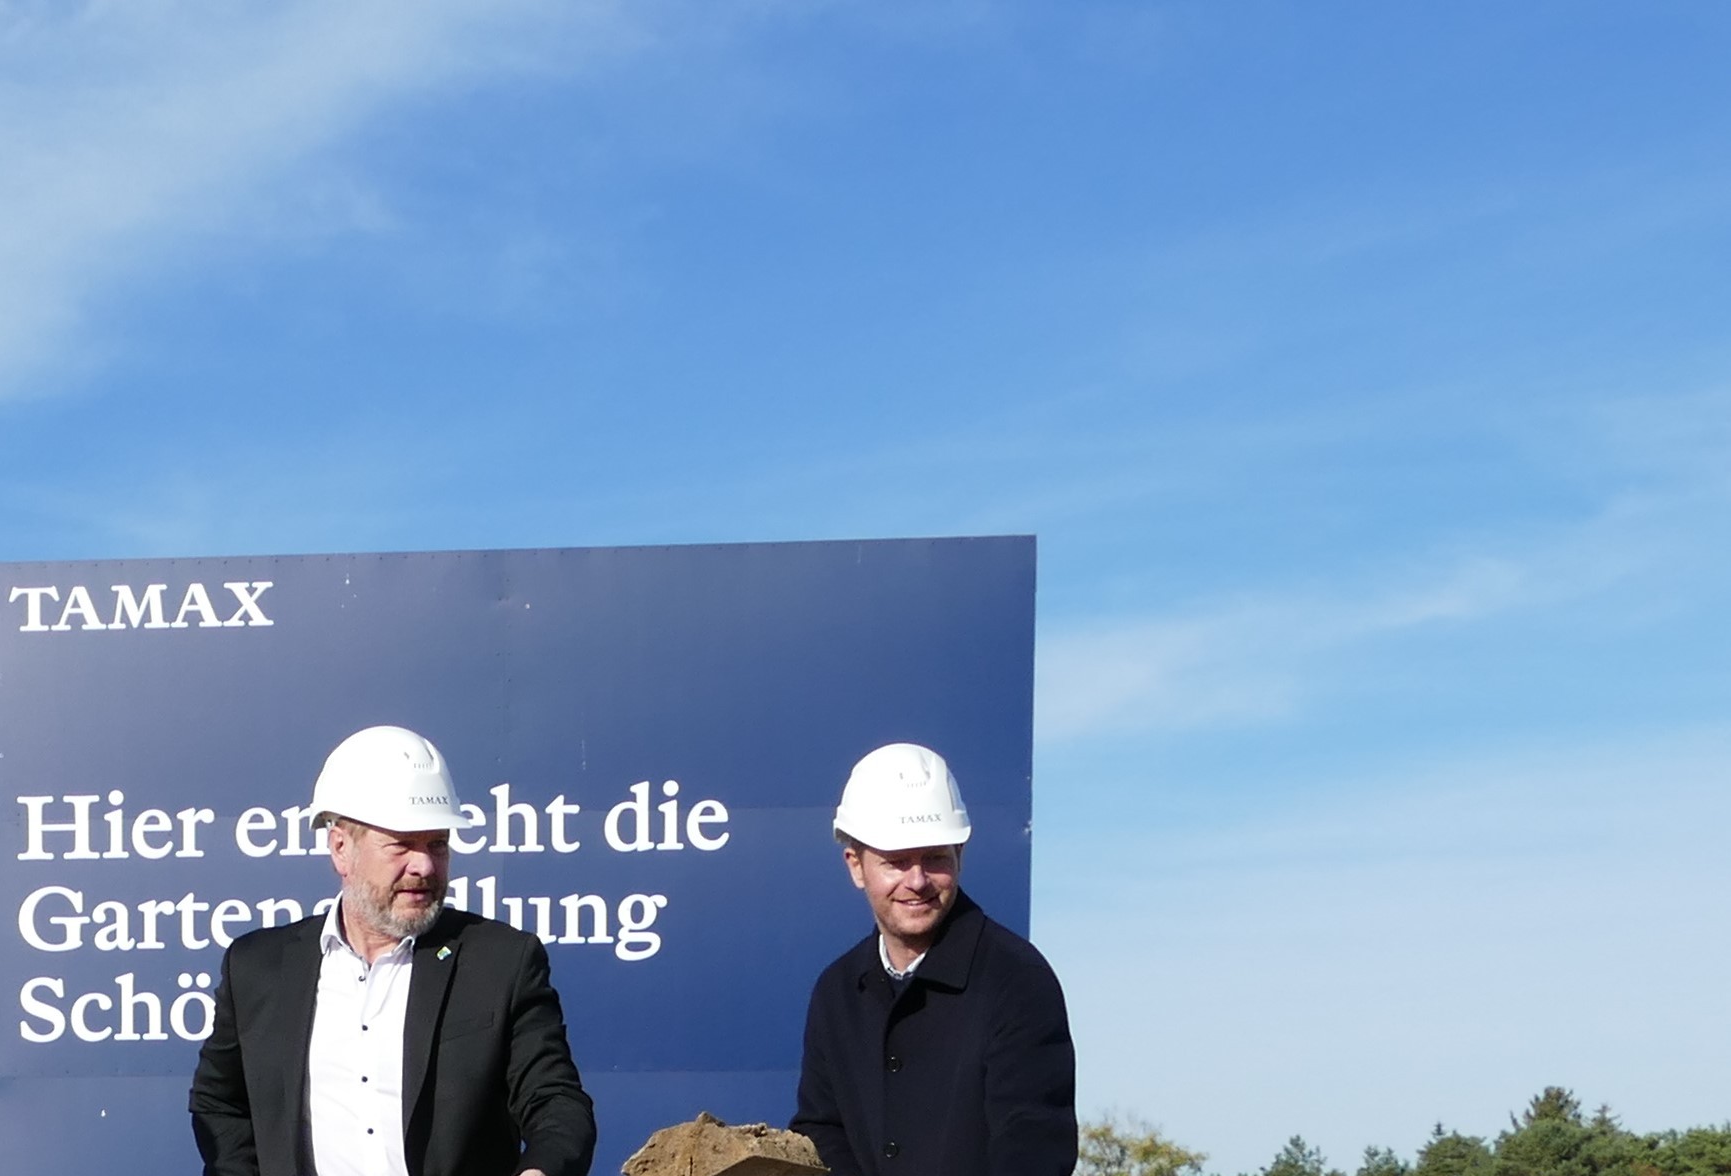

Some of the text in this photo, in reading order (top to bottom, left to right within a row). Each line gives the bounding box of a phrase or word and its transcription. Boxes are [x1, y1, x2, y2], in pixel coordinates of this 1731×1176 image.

[8, 581, 275, 632] TAMAX
[17, 789, 216, 860] Hier
[604, 780, 730, 852] die
[409, 796, 449, 806] TAMAX
[899, 813, 943, 825] TAMAX
[20, 972, 216, 1042] Schö
